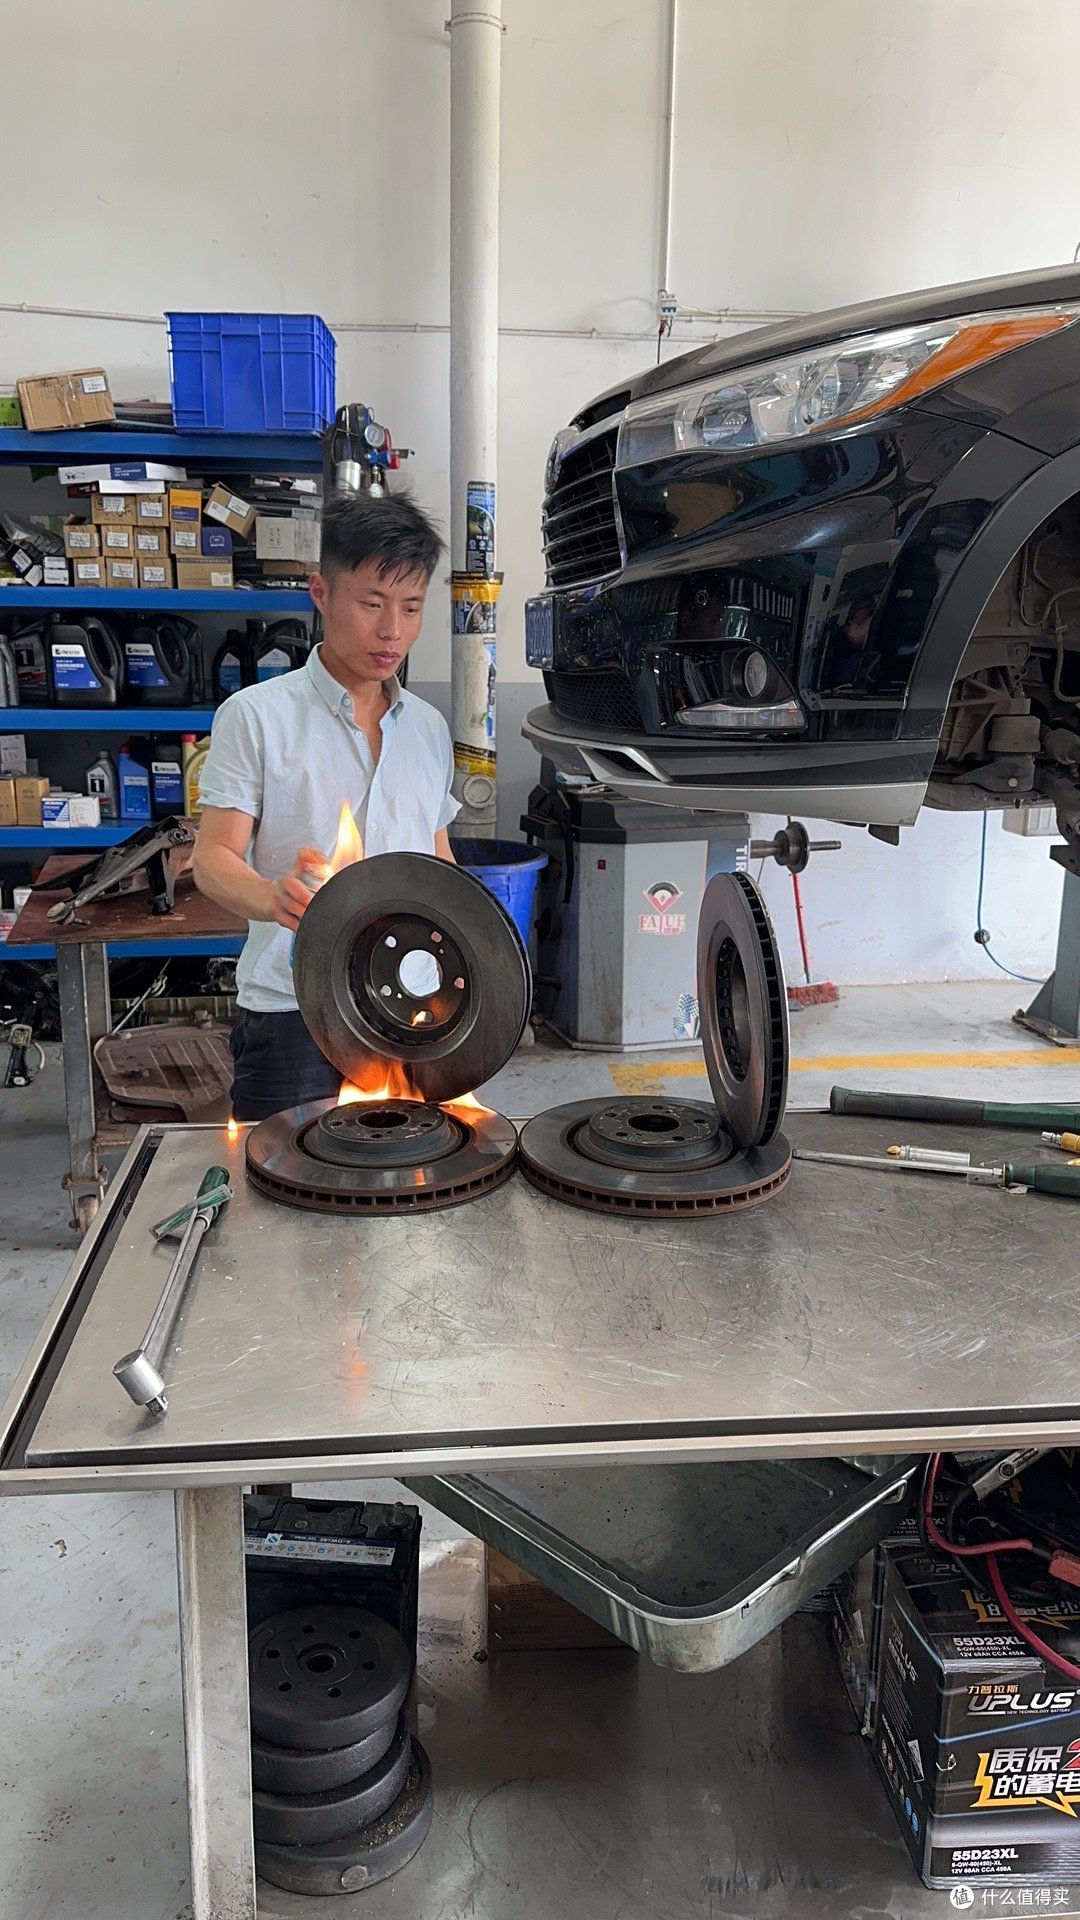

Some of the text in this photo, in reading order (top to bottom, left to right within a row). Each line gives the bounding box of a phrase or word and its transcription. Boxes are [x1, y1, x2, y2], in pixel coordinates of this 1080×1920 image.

[735, 844, 748, 872] TIR
[952, 1636, 1026, 1646] 55D23XL
[968, 1684, 1020, 1695] 力普拉斯
[967, 1691, 1076, 1711] UPLUS
[951, 1848, 1019, 1861] 55D23XL
